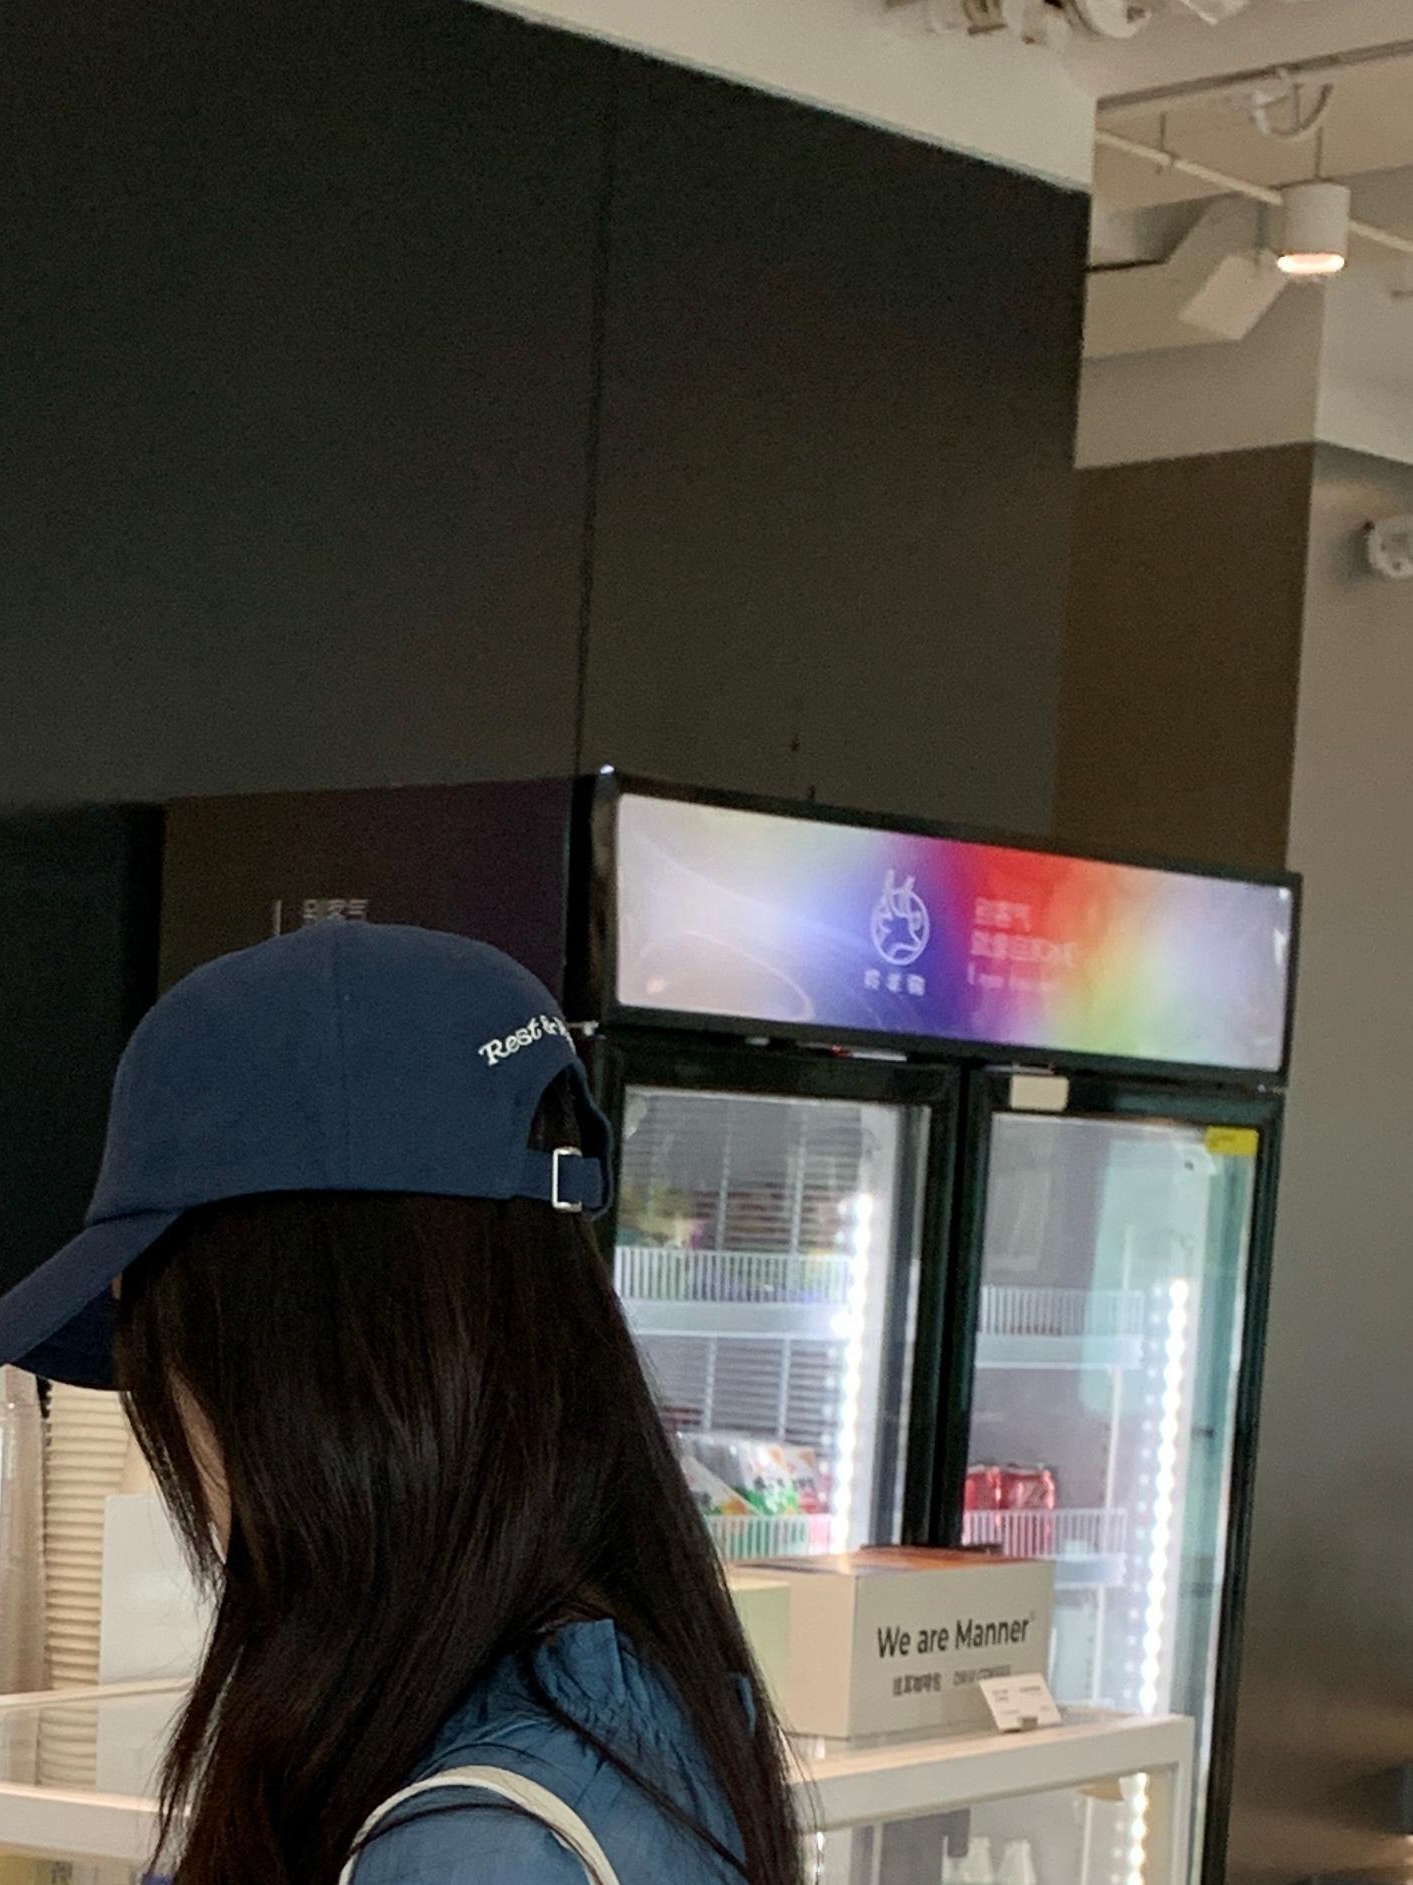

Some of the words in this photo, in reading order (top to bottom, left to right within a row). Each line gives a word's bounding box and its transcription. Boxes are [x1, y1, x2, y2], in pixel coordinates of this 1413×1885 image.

[478, 1018, 543, 1066] Rest
[877, 1625, 911, 1658] We
[917, 1626, 949, 1653] are
[955, 1617, 1030, 1649] Manner
